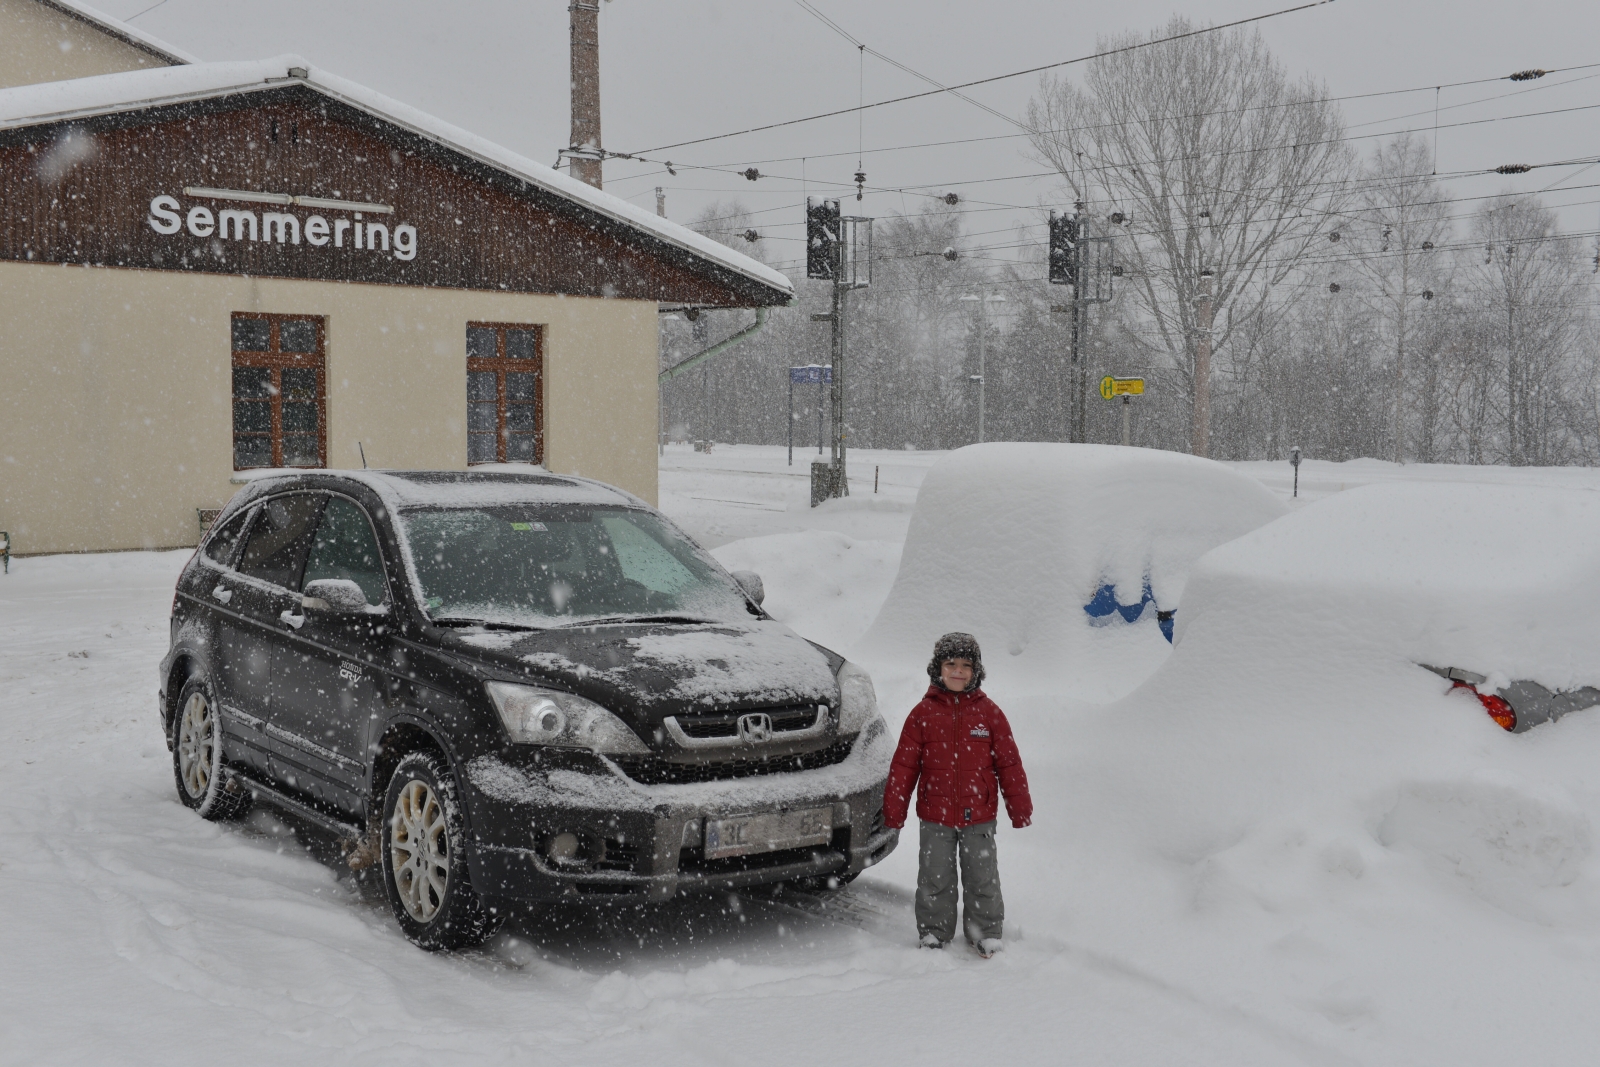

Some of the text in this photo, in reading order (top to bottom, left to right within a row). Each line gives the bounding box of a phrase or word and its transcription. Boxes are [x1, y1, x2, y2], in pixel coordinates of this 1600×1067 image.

[150, 195, 417, 261] Semmering
[1103, 379, 1113, 396] H
[341, 660, 363, 675] HONDA
